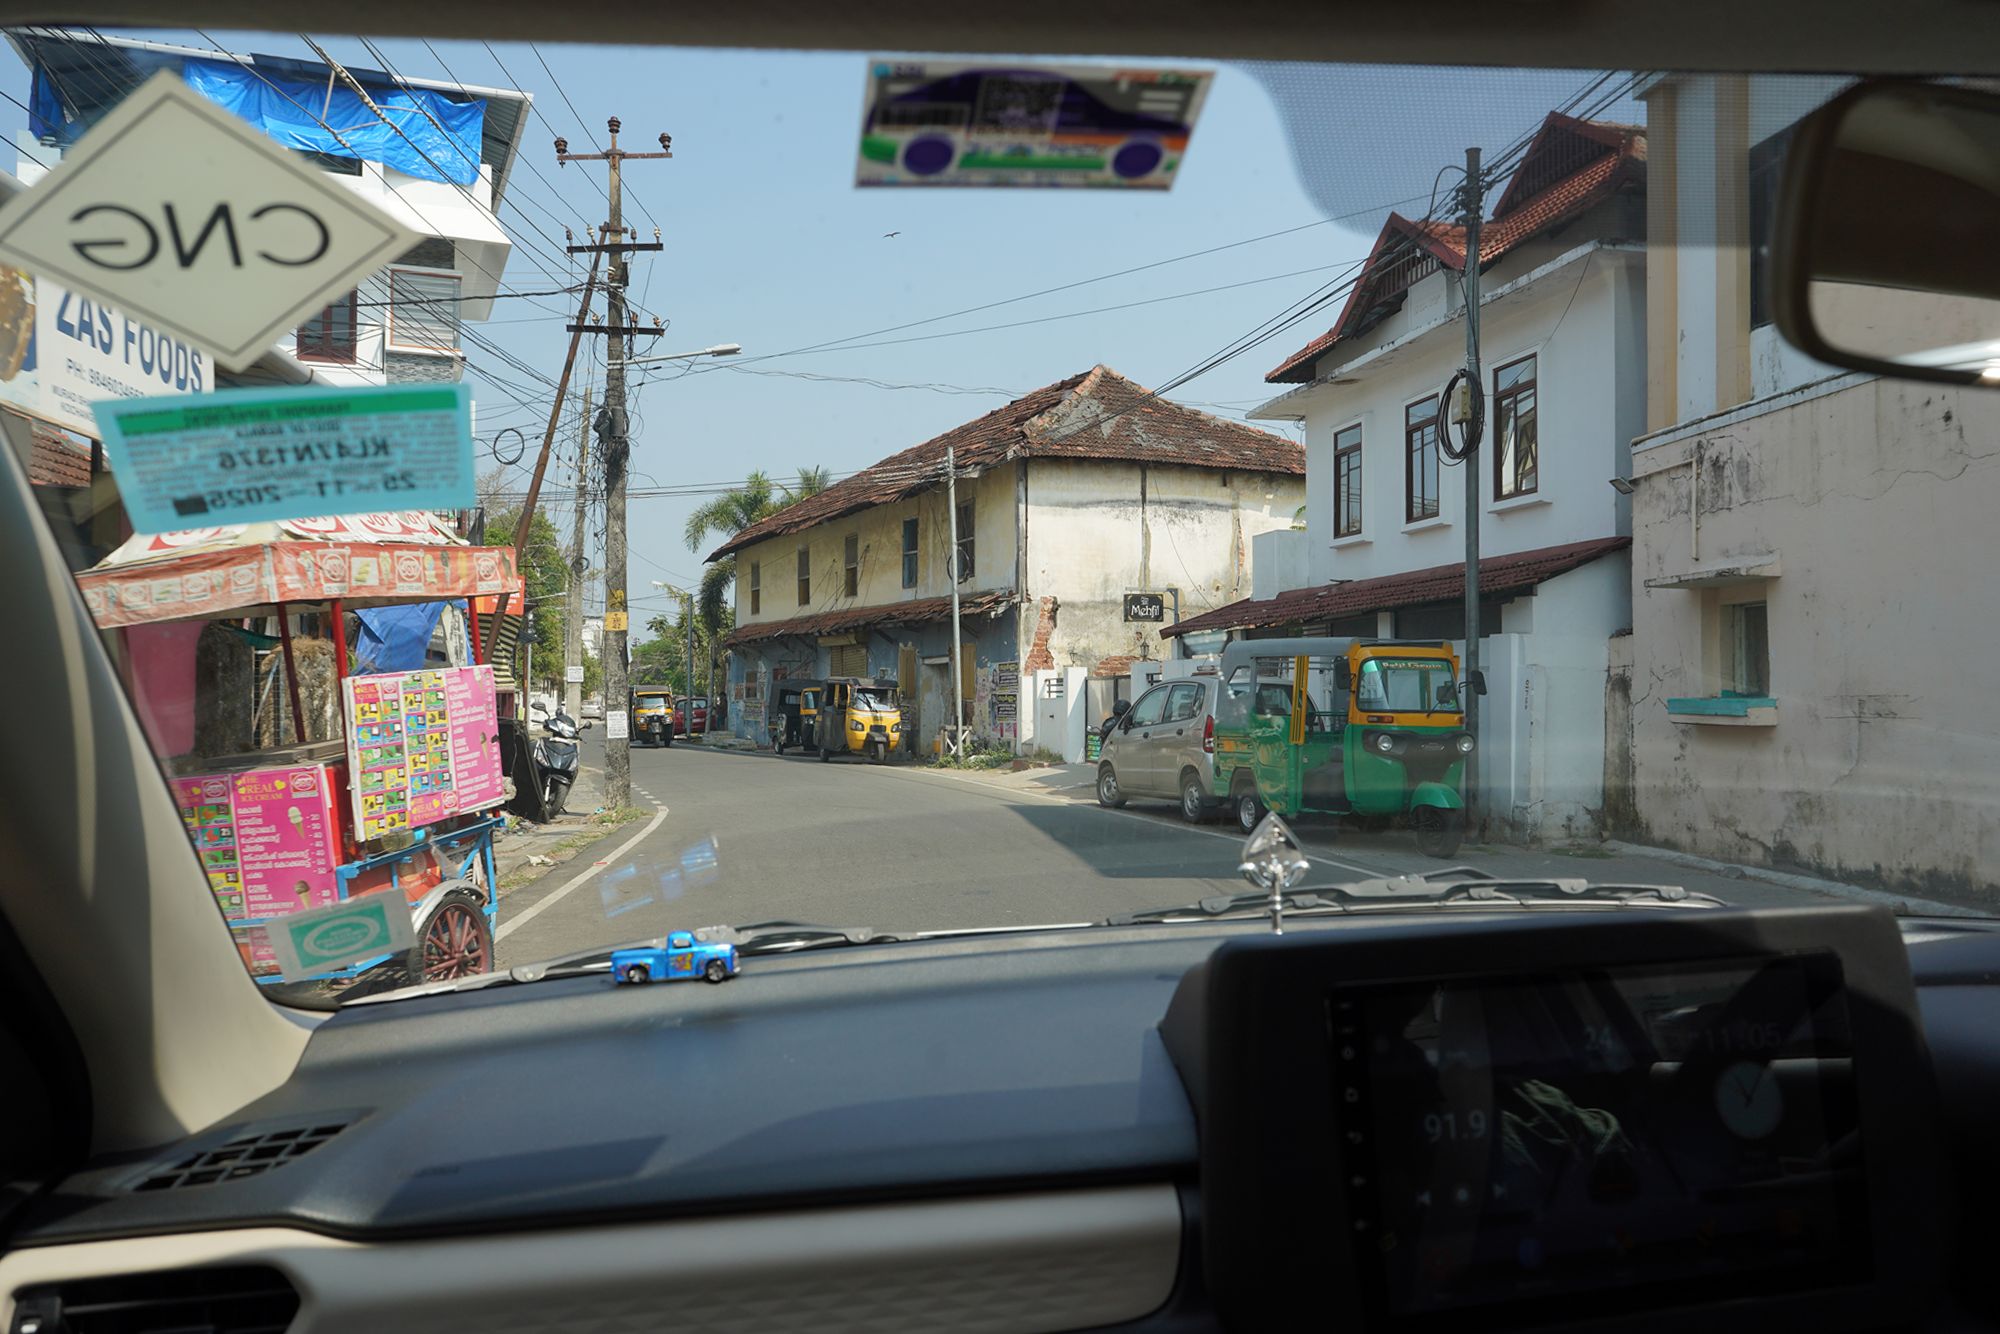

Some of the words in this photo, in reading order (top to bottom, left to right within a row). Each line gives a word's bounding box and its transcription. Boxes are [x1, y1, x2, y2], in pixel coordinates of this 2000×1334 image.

[124, 318, 202, 393] FOODS
[1131, 605, 1160, 618] Mehfil
[1424, 1110, 1487, 1142] 91.9
